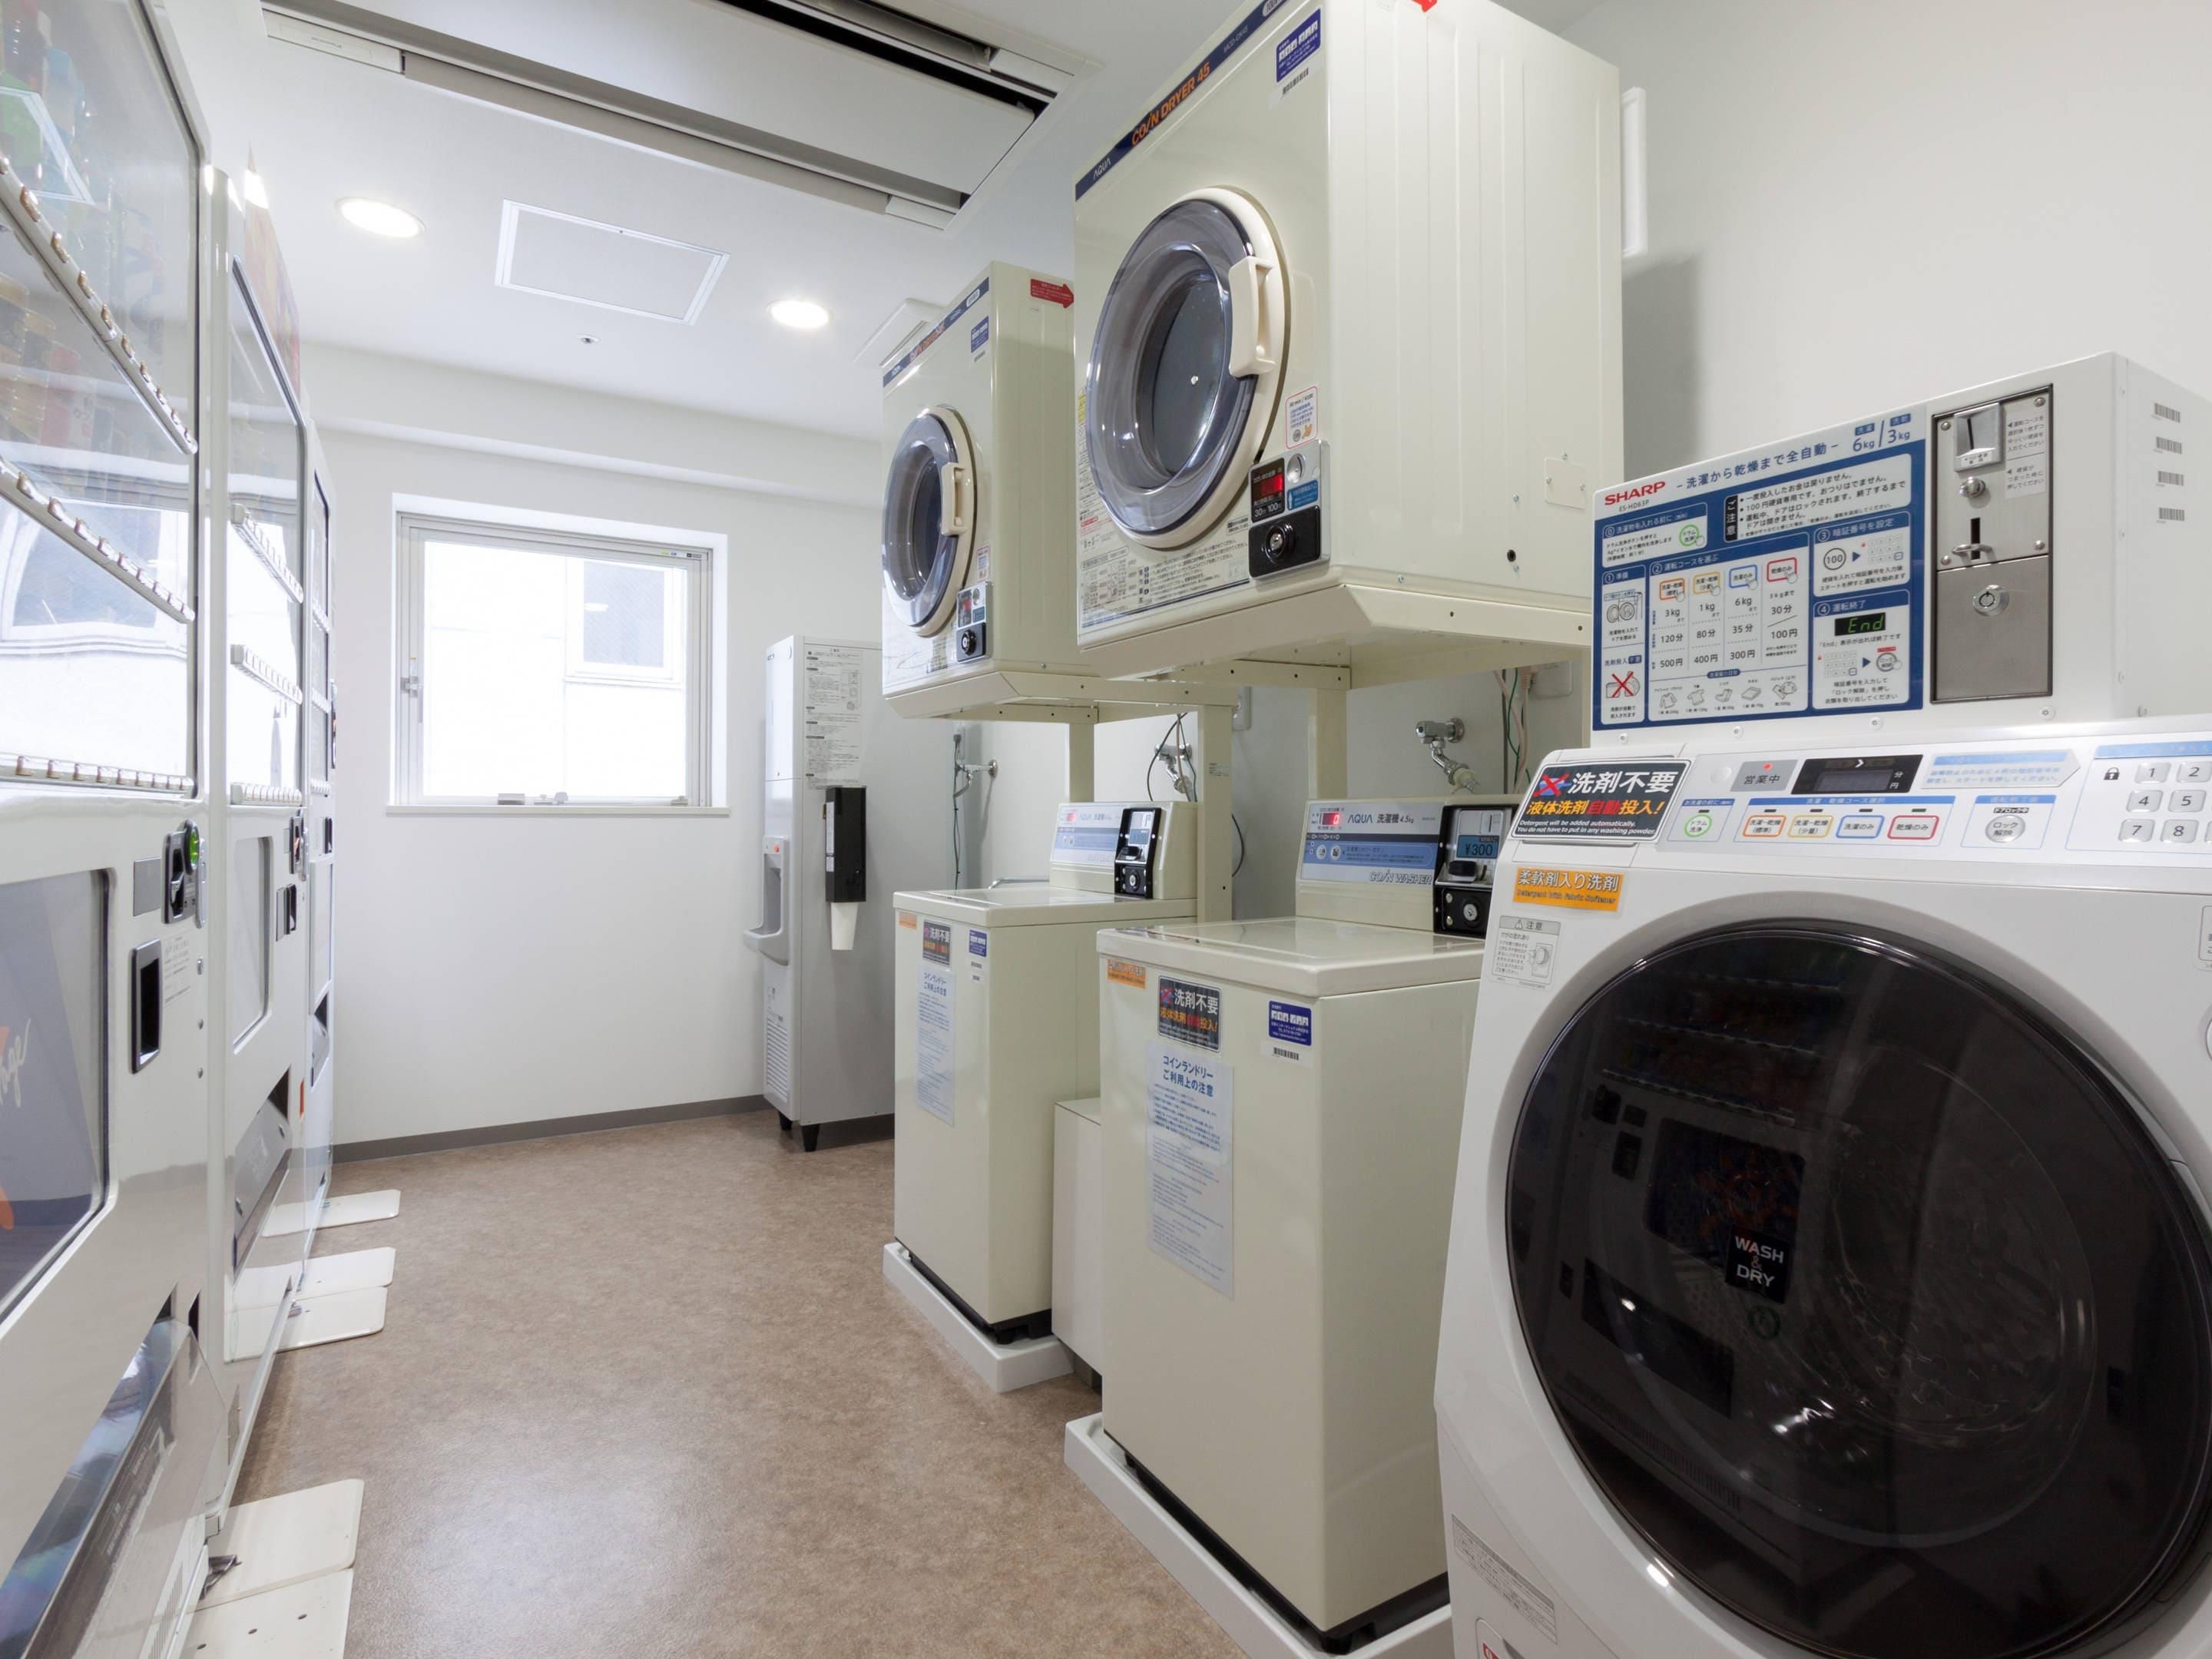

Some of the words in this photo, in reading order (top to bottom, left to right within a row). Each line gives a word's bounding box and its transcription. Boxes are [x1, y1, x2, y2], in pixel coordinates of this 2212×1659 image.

[1093, 157, 1111, 180] AQUA
[1161, 77, 1196, 119] DRYER
[1197, 61, 1210, 82] 45
[1686, 442, 1827, 489] 洗濯から乾燥まで全自動
[1853, 438, 1875, 452] 6kg
[1888, 429, 1910, 444] 3kg
[1604, 482, 1666, 505] SHARP
[1727, 500, 1737, 536] ご注意
[1833, 518, 1894, 537] 暗証番号を設定
[1664, 554, 1718, 571] 運転コースを選ぶ
[1827, 555, 1843, 565] 100
[1833, 600, 1866, 612] 運転終了
[1848, 615, 1884, 634] End
[1770, 628, 1798, 639] 100円
[1694, 654, 1718, 664] 400円
[1730, 649, 1756, 660] 300円
[1660, 658, 1683, 668] 500円
[2149, 767, 2155, 777] 1
[2188, 767, 2200, 777] 2
[1568, 770, 1679, 794] 洗剤不要
[1744, 773, 1780, 785] 営業中
[2138, 796, 2149, 806] 4
[2181, 795, 2192, 806] 5
[1333, 813, 1339, 825] 0
[1347, 814, 1373, 824] AQUA
[1377, 813, 1399, 824] 洗濯機
[1399, 815, 1415, 824] 4.5kg
[1590, 820, 1636, 829] automatically.
[1599, 827, 1628, 836] washing
[1993, 821, 2018, 830] ロック
[2132, 825, 2142, 836] 7
[2173, 825, 2184, 836] 8
[1465, 843, 1493, 856] ¥300
[1396, 873, 1434, 885] WASHER
[1518, 870, 1620, 892] 柔軟剤入り洗剤
[1526, 921, 1543, 931] 注意
[1174, 988, 1218, 1015] 洗剤不要
[1163, 1055, 1214, 1078] コインランドリー
[1163, 1069, 1214, 1097] ご利用上の注意
[1734, 1236, 1784, 1263] WASH
[1750, 1255, 1763, 1270] &
[1737, 1263, 1776, 1287] DRY
